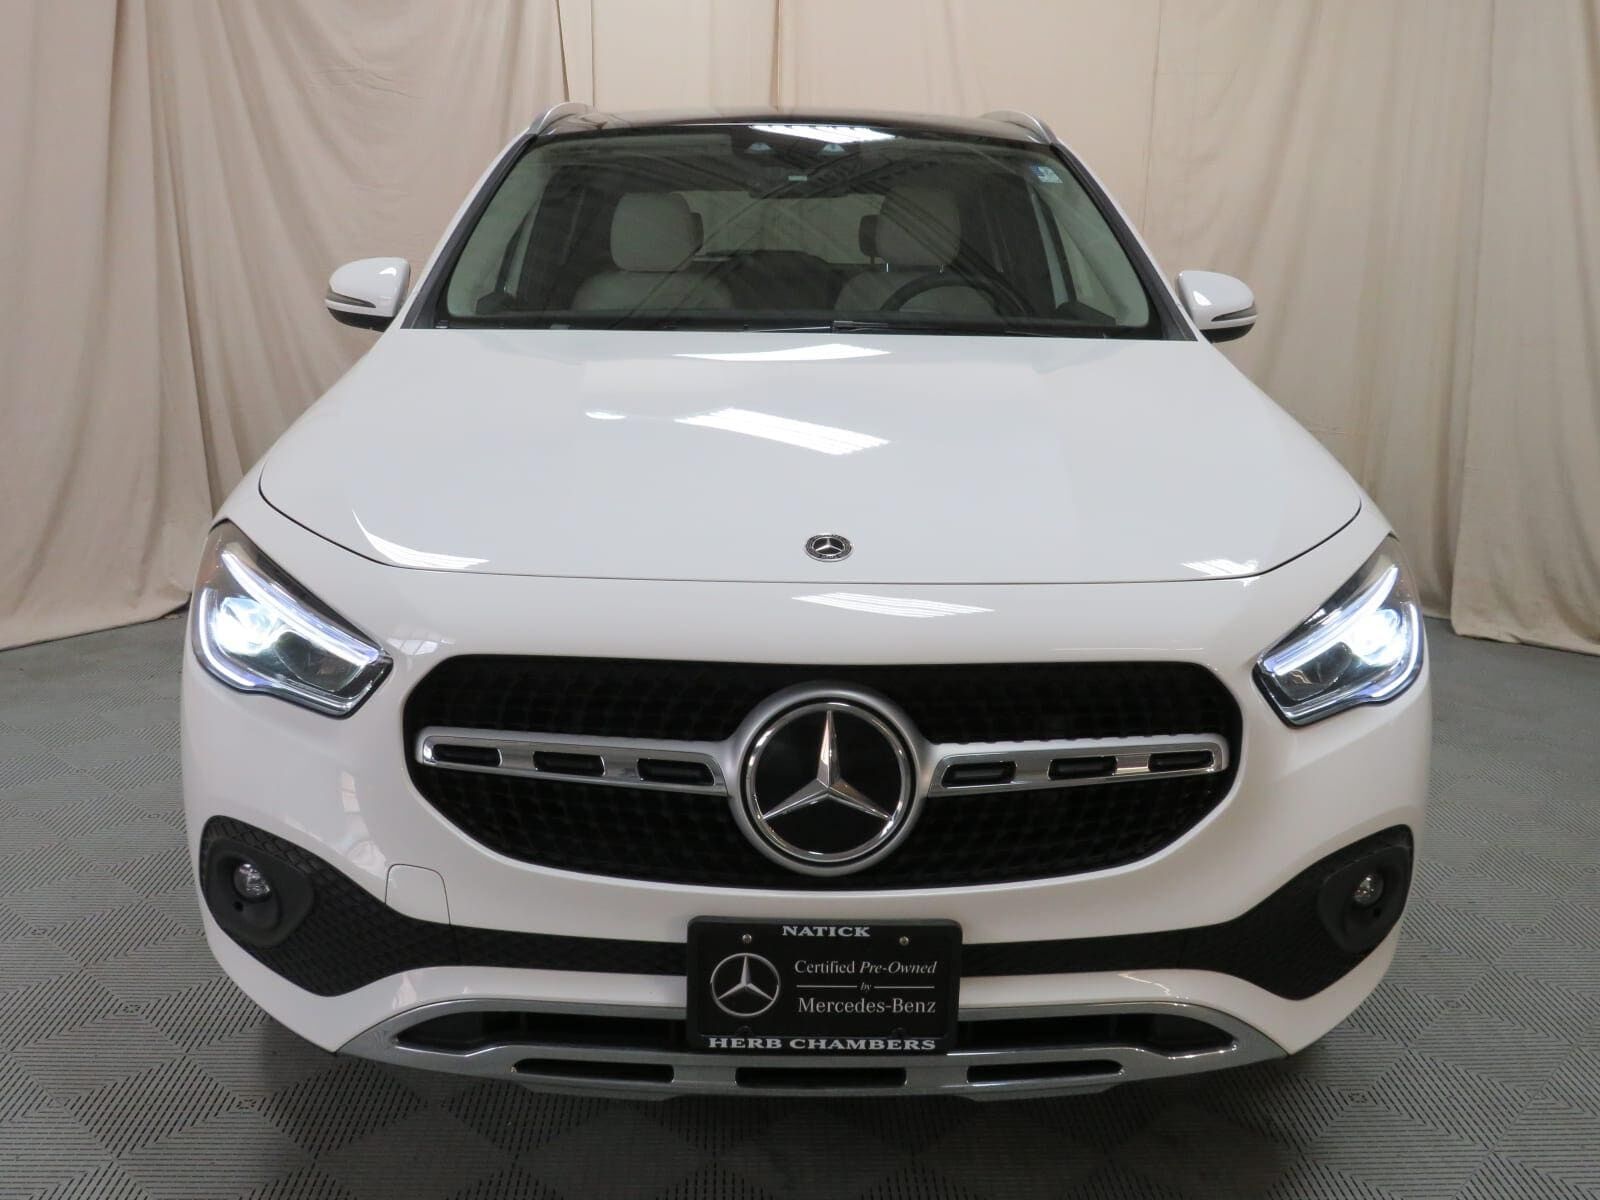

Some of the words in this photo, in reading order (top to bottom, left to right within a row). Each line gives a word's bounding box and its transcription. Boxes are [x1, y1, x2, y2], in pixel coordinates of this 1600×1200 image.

[782, 925, 870, 937] NATICK
[794, 960, 855, 974] Certified
[859, 961, 937, 974] Pre-Owned
[860, 982, 872, 992] by
[798, 998, 936, 1014] Mercedes-Benz
[708, 1037, 782, 1049] HERB
[789, 1038, 936, 1050] CHAMBERS
